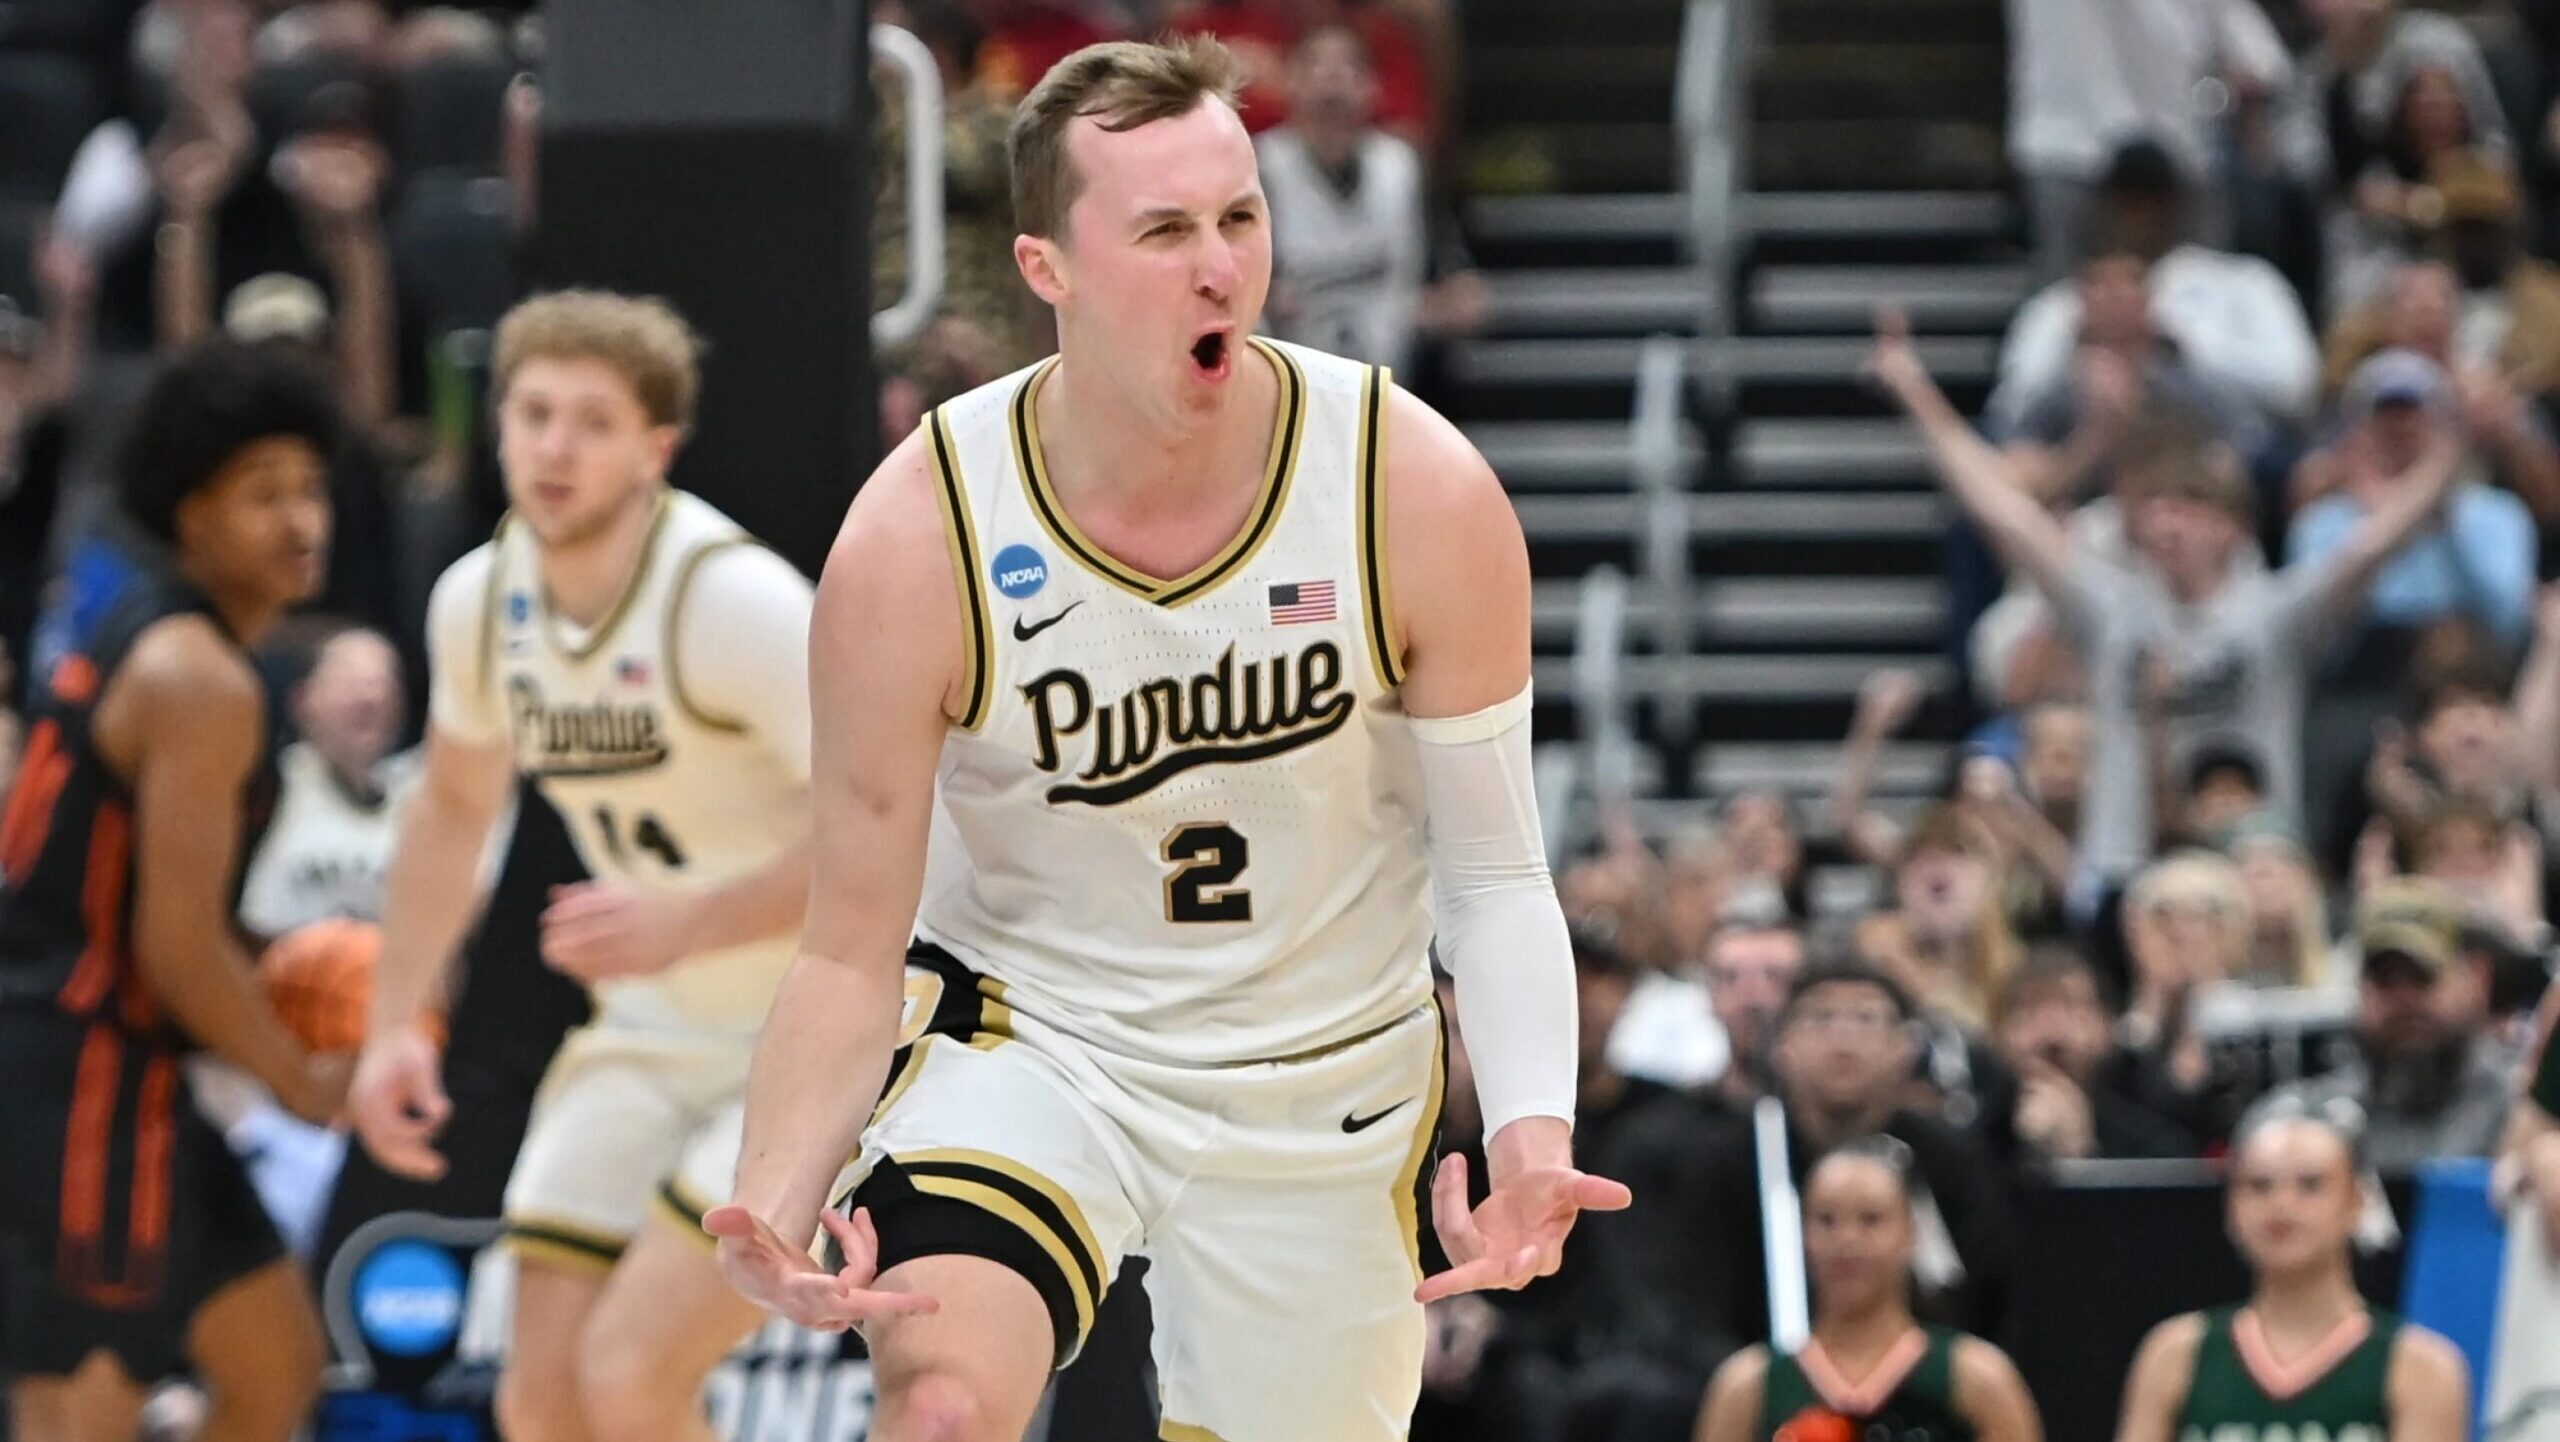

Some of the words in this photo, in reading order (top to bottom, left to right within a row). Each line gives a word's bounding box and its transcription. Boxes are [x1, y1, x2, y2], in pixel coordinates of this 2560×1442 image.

[1000, 565, 1045, 589] NCAA
[1017, 640, 1357, 806] Purdue
[594, 804, 685, 870] 14
[1160, 820, 1252, 923] 2
